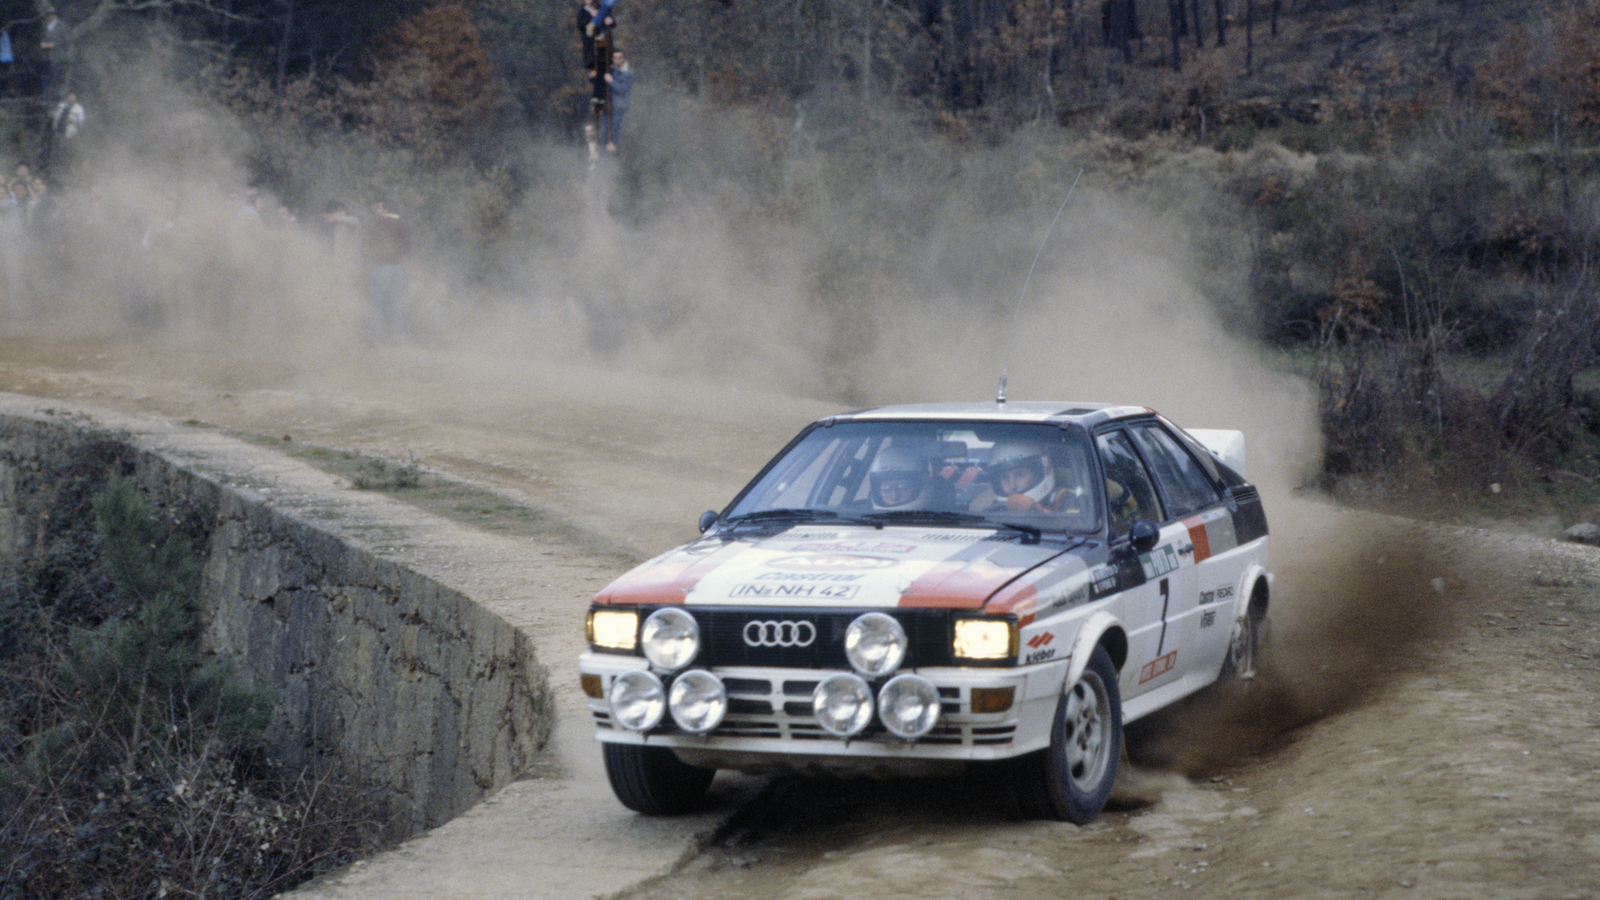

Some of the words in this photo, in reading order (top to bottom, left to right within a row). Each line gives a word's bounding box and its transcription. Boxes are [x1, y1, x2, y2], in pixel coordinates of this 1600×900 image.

[754, 571, 866, 581] Castrol
[775, 585, 816, 595] NH
[820, 586, 851, 597] 42
[1157, 576, 1169, 657] 7
